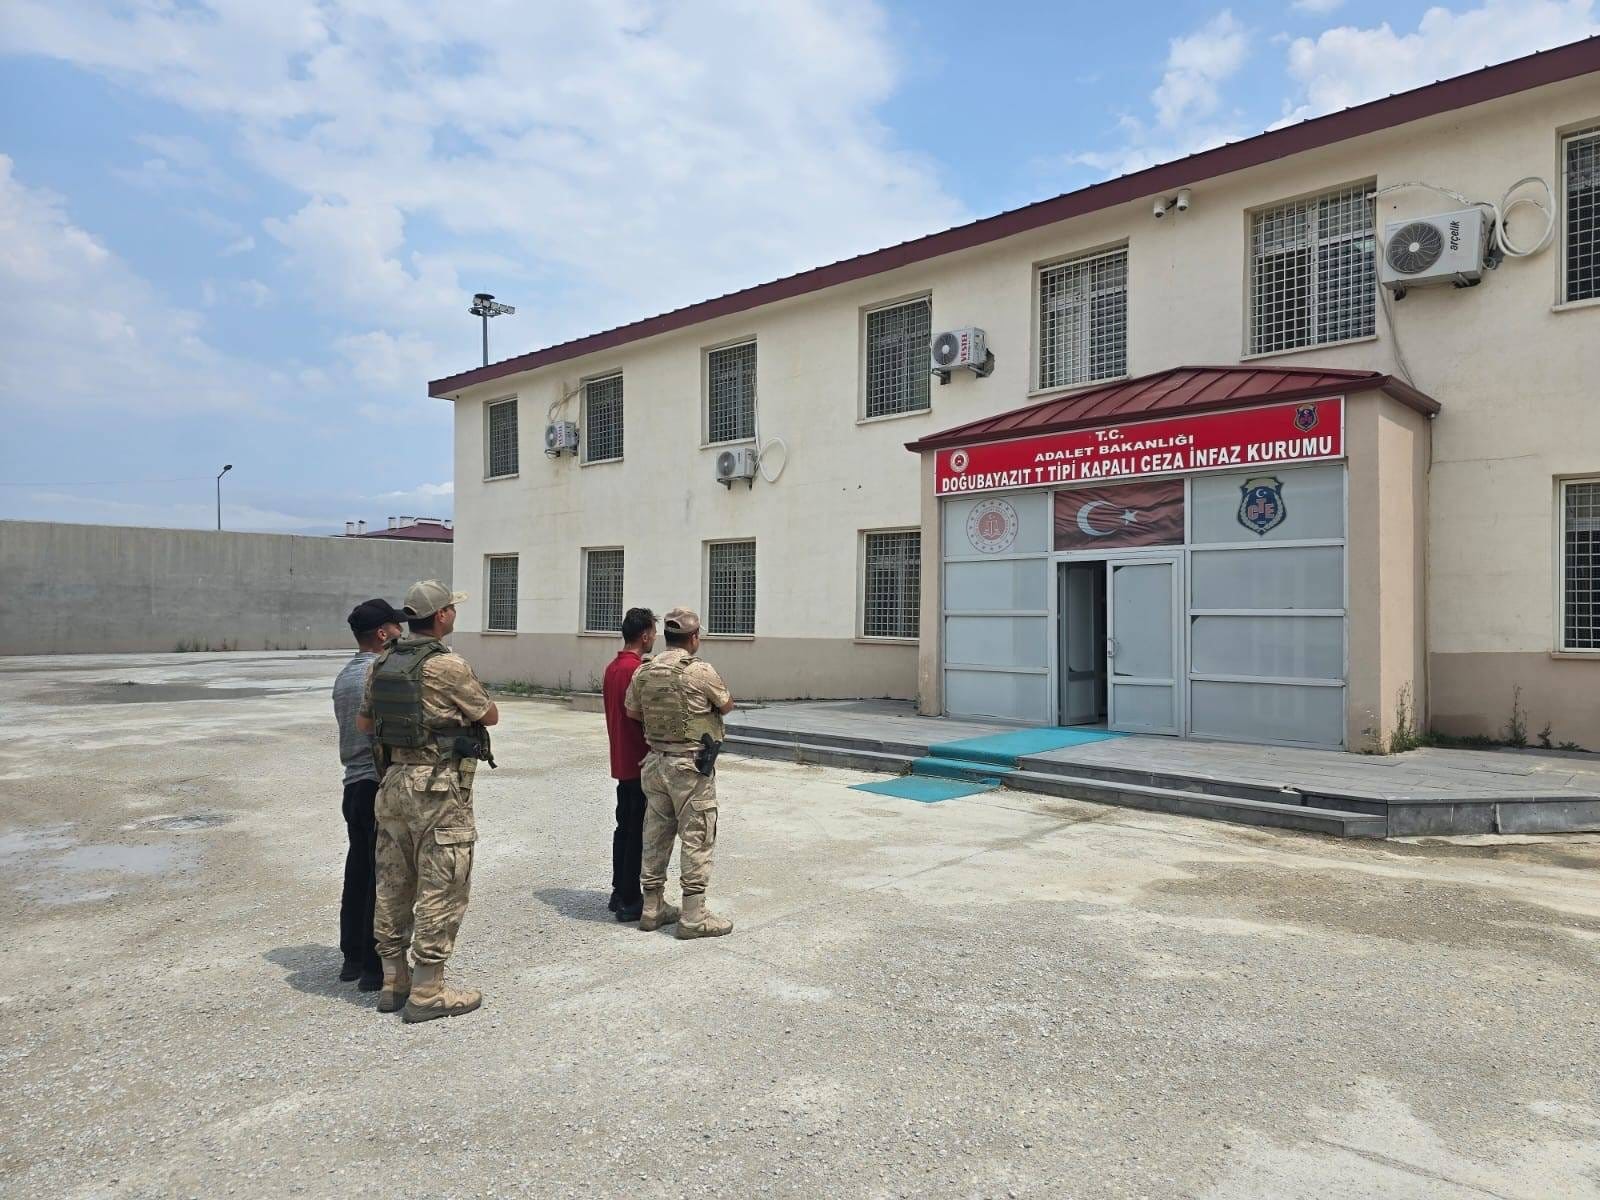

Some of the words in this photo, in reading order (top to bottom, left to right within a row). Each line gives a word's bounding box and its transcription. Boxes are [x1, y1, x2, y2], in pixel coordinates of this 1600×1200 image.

[1450, 221, 1460, 251] arçelik
[1034, 447, 1094, 462] ADALET
[1099, 434, 1194, 454] BAKANLIĞI
[1096, 429, 1125, 441] T.C.
[942, 469, 1031, 492] DOĞUBAYAZIT
[1035, 467, 1044, 482] T
[1048, 460, 1076, 481] TİPİ
[1081, 457, 1135, 478] KAPALI
[1141, 452, 1184, 472] CEZA
[1189, 445, 1241, 467] İNFAZ
[1247, 436, 1332, 461] KURUMU
